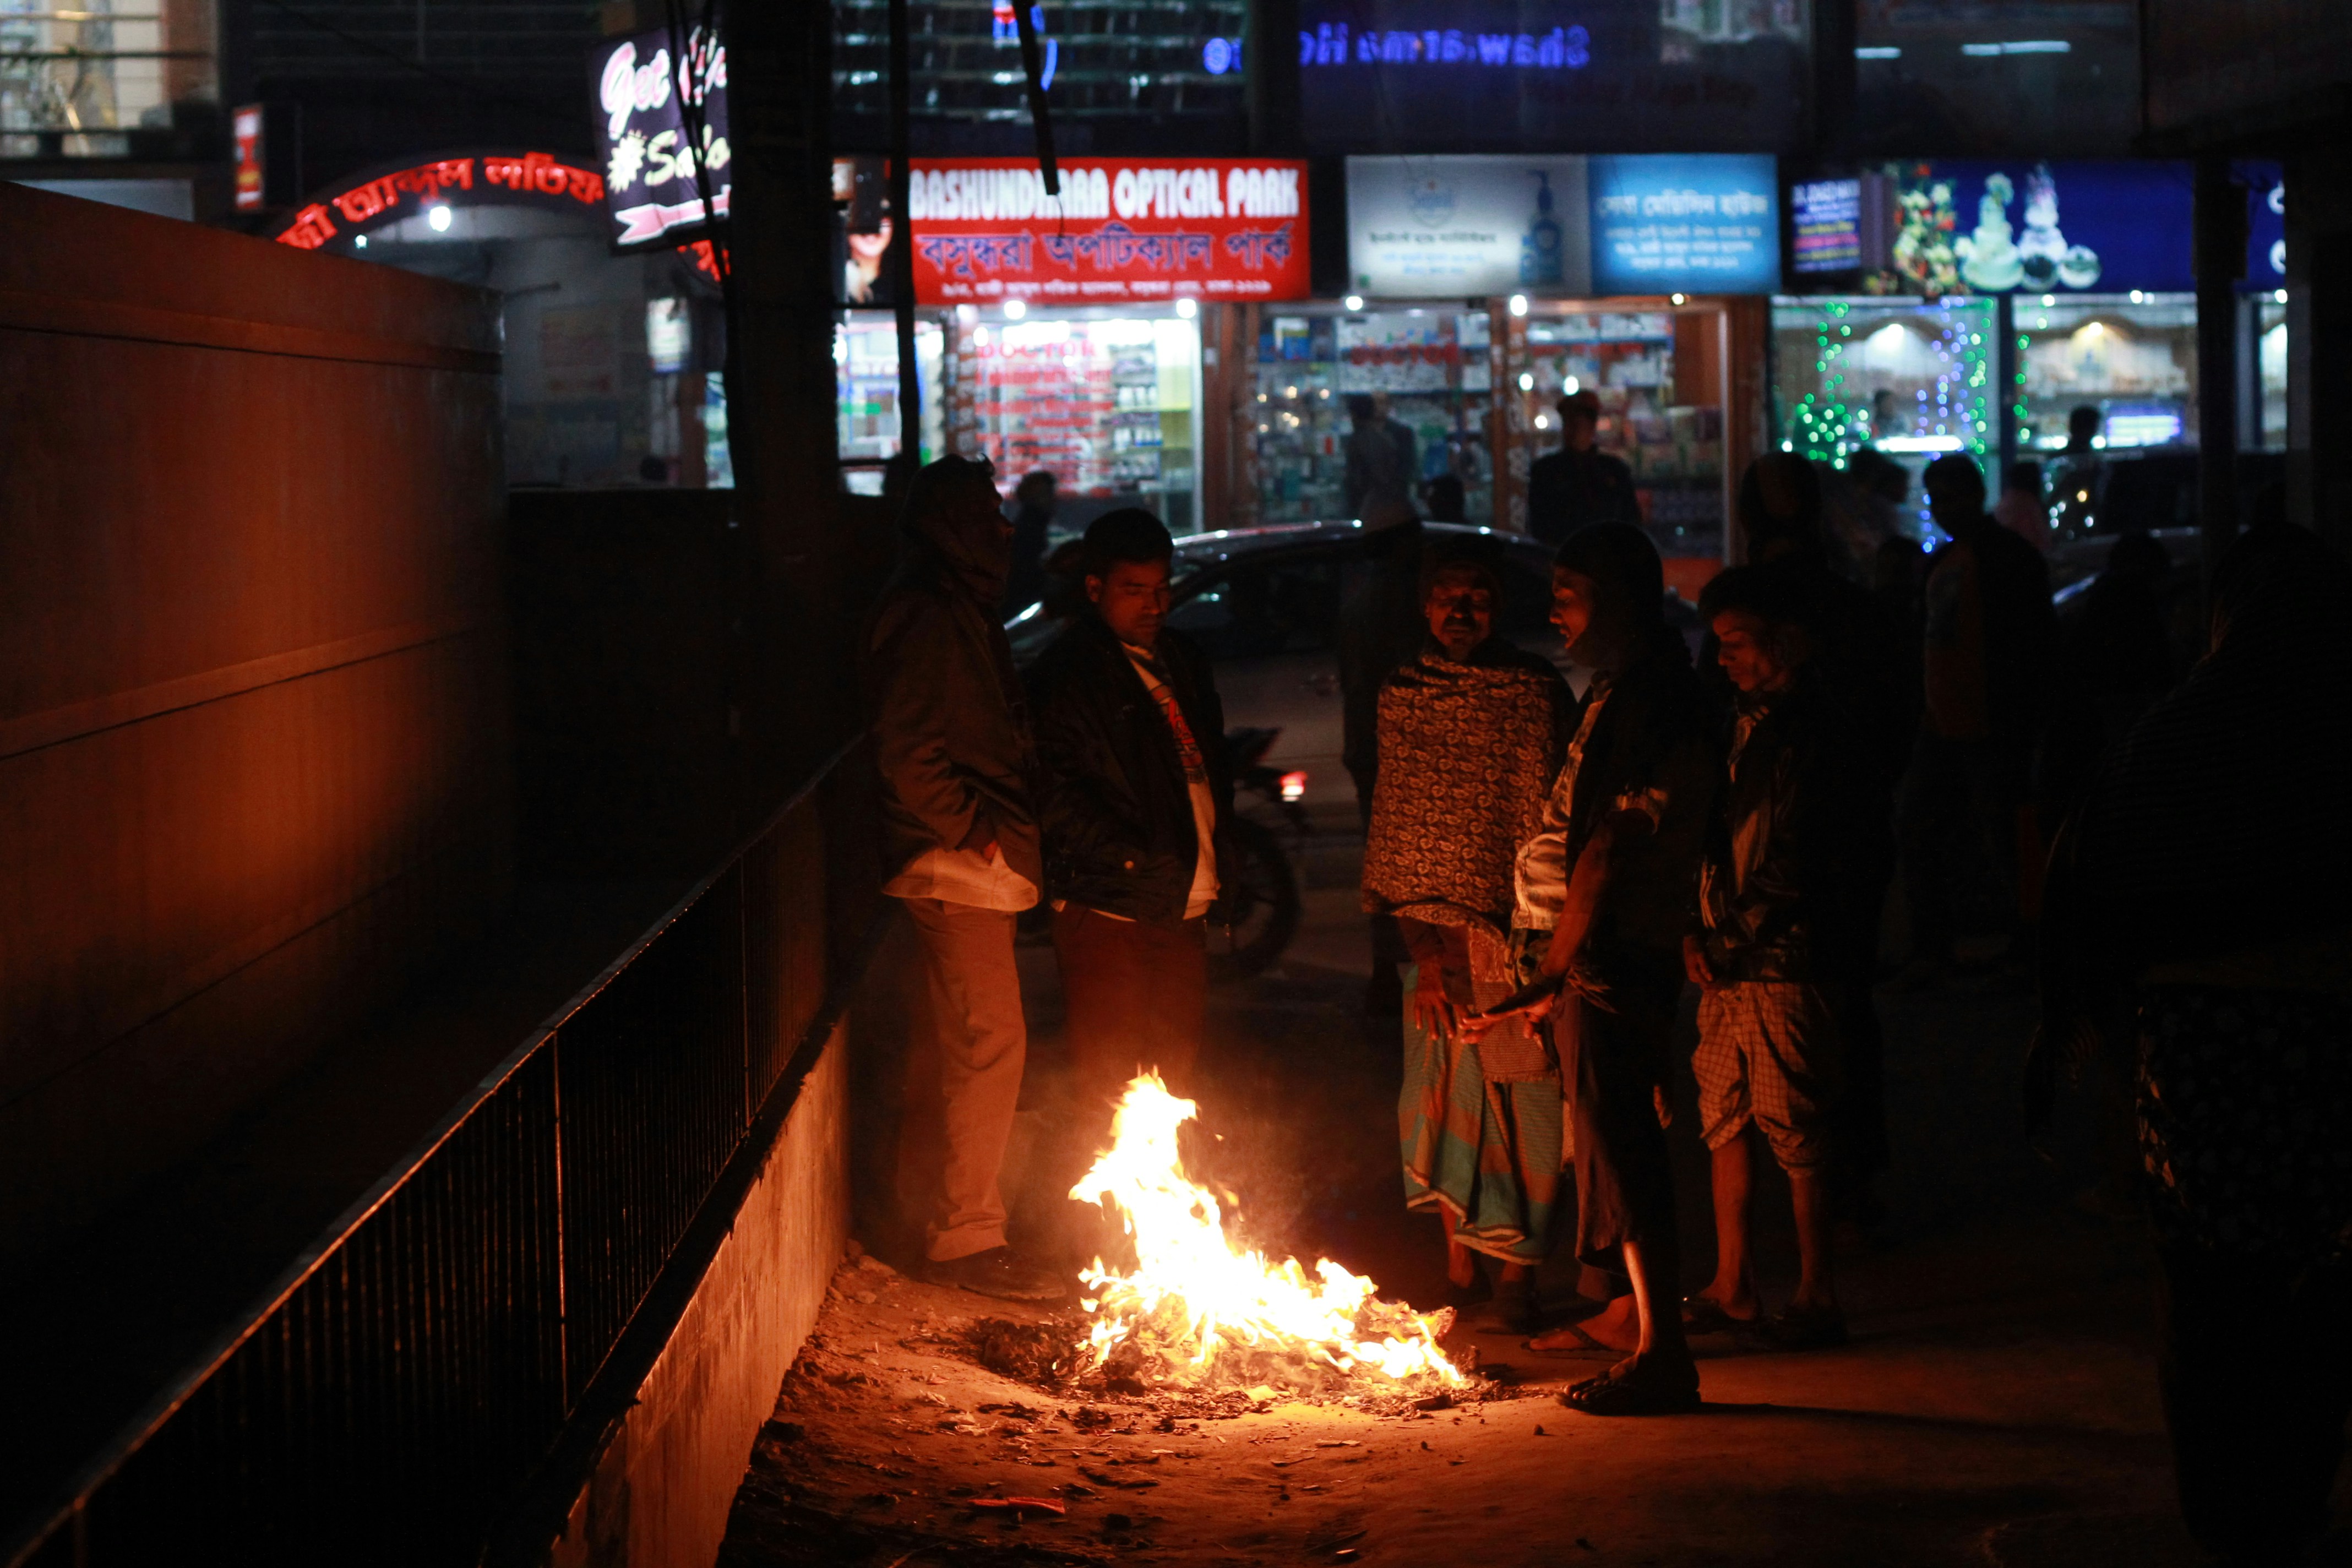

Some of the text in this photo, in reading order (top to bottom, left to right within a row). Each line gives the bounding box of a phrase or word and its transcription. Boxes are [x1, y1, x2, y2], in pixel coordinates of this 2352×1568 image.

[600, 41, 671, 140] Get
[482, 150, 605, 205] লতিফ
[908, 167, 1299, 220] BASHUNDHARA OPTICAL PARK
[914, 220, 1294, 279] বসুন্ধরা অপটিক্যাল পার্ক
